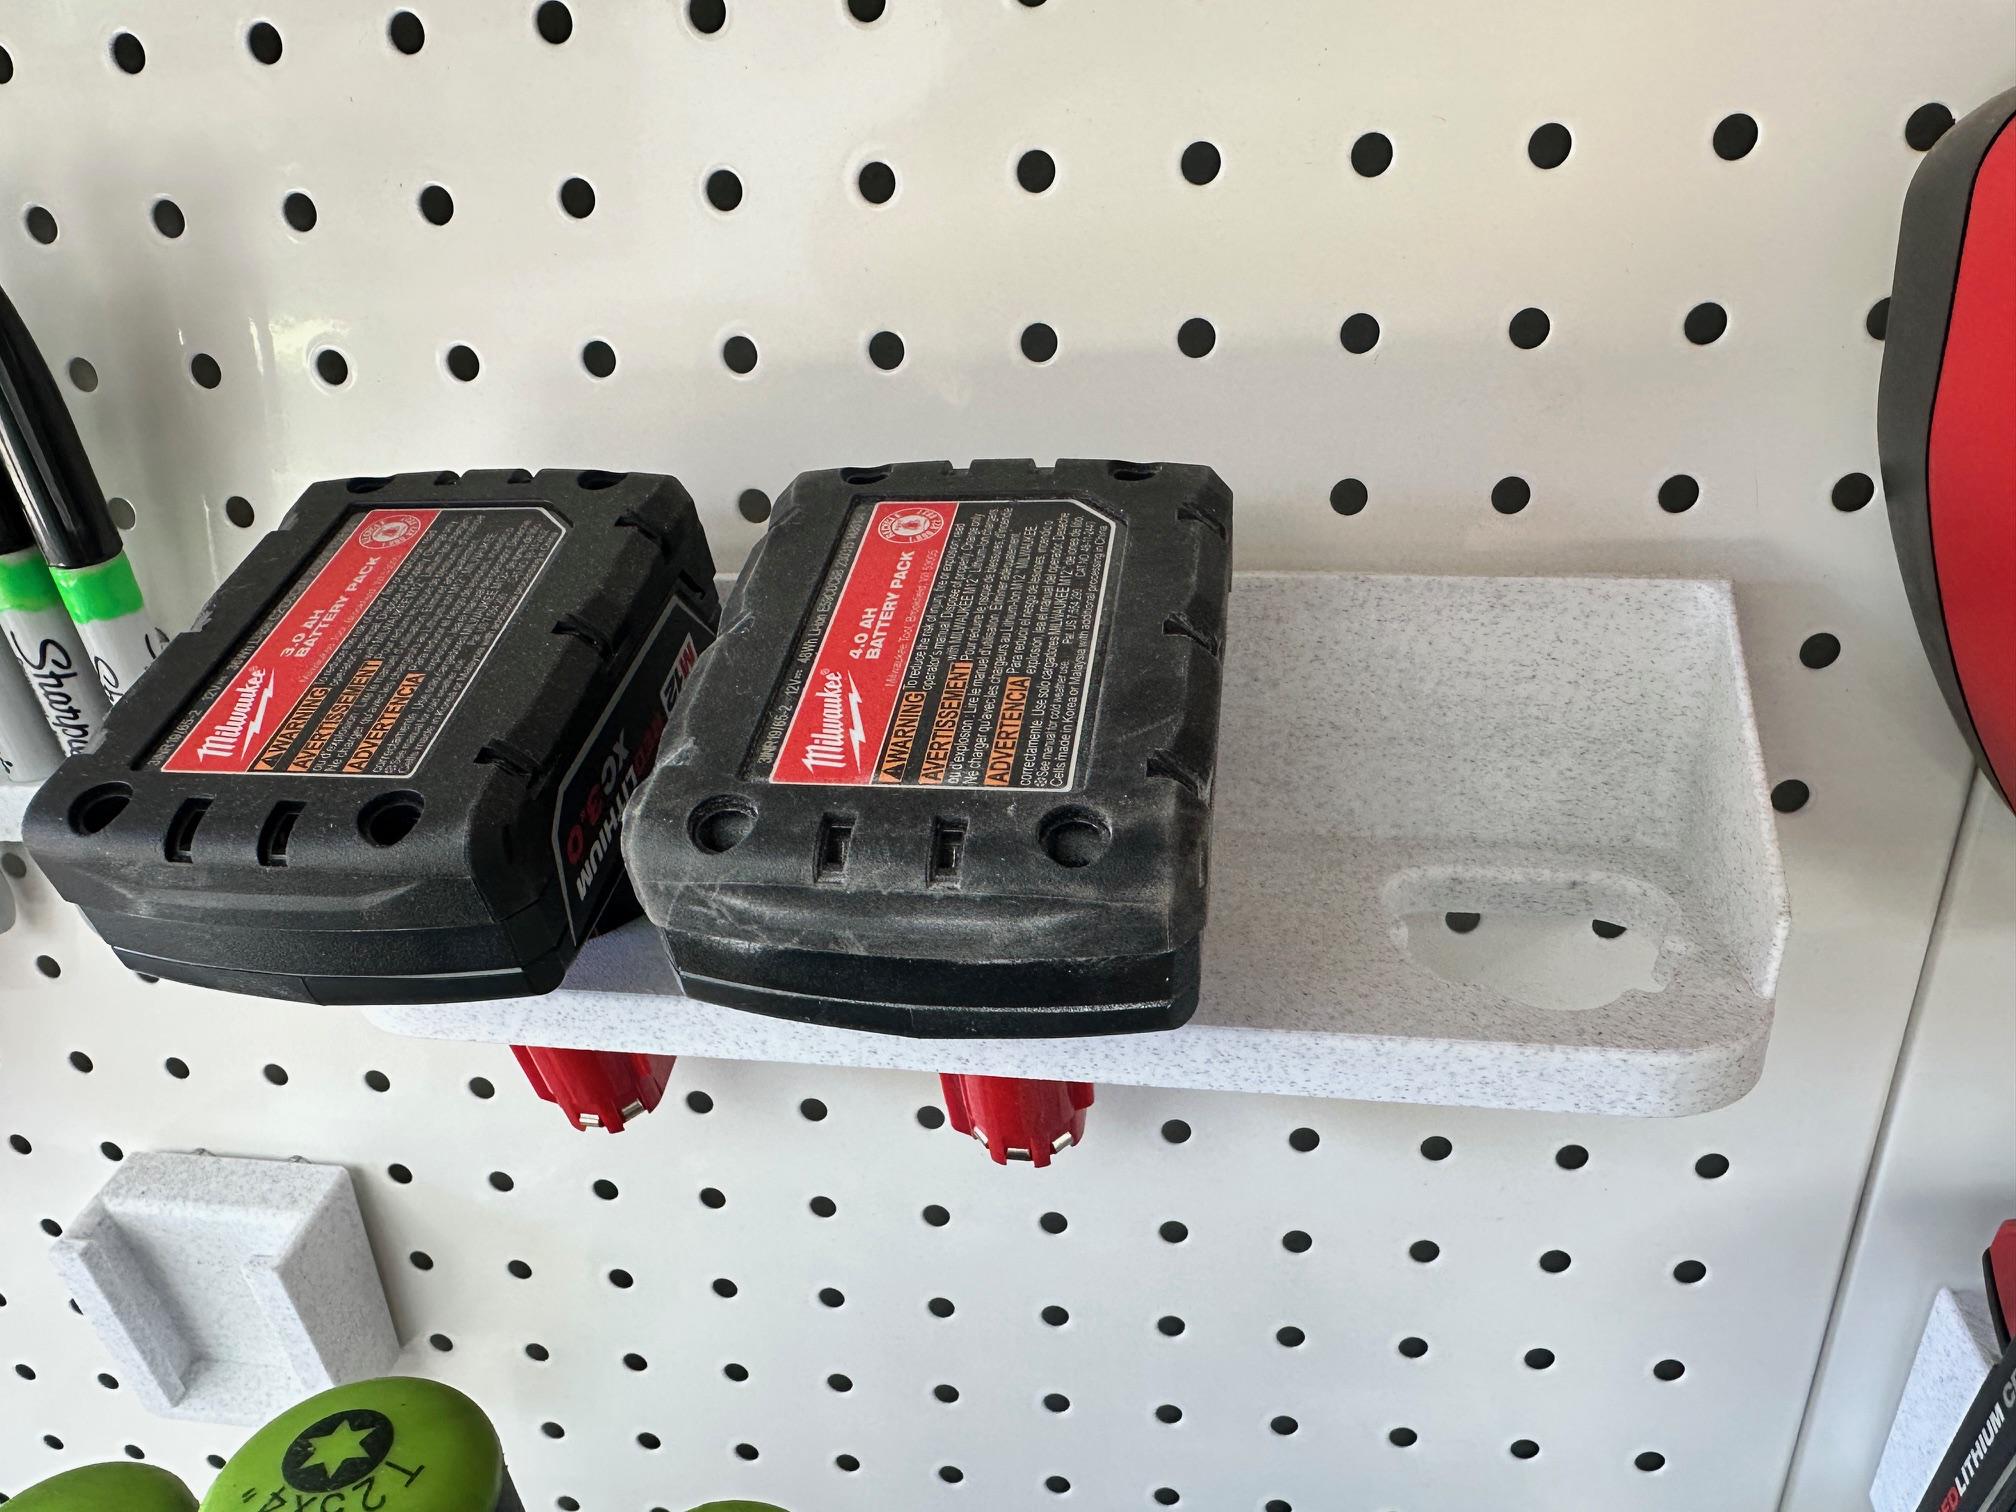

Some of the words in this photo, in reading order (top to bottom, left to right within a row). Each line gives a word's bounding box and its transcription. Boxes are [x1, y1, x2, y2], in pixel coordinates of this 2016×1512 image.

[1023, 584, 1039, 594] de
[1035, 585, 1055, 612] manual
[292, 594, 353, 657] BATTERY
[342, 555, 382, 591] PACK
[856, 607, 879, 628] AH
[863, 591, 902, 659] BATTERY
[888, 549, 916, 588] PACK
[1077, 591, 1097, 630] additional
[919, 622, 935, 636] risk
[923, 614, 938, 622] of
[1016, 618, 1031, 626] el
[277, 632, 309, 657] 3.0
[299, 608, 327, 629] AH
[845, 632, 870, 659] 4.0
[915, 636, 931, 650] the
[918, 650, 945, 690] operator's
[939, 588, 963, 617] Dispose
[998, 632, 1012, 643] au
[1074, 630, 1090, 647] with
[906, 650, 927, 678] reduce
[943, 644, 960, 660] with
[958, 641, 978, 660] Pour
[985, 643, 1013, 684] chargeurs
[1004, 654, 1023, 674] Para
[1037, 635, 1064, 680] cargadores
[969, 655, 990, 687] manuel
[1067, 648, 1089, 685] Malaysia
[902, 679, 918, 688] To
[966, 687, 983, 696] le
[982, 684, 1000, 697] les
[1049, 674, 1068, 702] weather
[1066, 686, 1080, 695] or
[288, 660, 382, 768] AVERTISSEMENT
[961, 695, 980, 713] Lire
[973, 697, 999, 731] qu'avec
[1029, 698, 1048, 716] Use
[1045, 703, 1062, 719] cold
[1060, 696, 1078, 723] Korea
[266, 687, 330, 751] WARNING
[344, 674, 426, 770] ADVERTENCIA
[884, 692, 926, 763] WARNING
[919, 663, 973, 781] AVERTISSEMENT
[985, 677, 1031, 782] ADVERTENCIA
[1058, 723, 1073, 733] in
[947, 719, 977, 770] d'explosion
[964, 732, 991, 769] charger
[1037, 729, 1057, 760] manual
[1052, 733, 1072, 761] made
[1034, 760, 1051, 777] See
[1048, 761, 1067, 786] Cells
